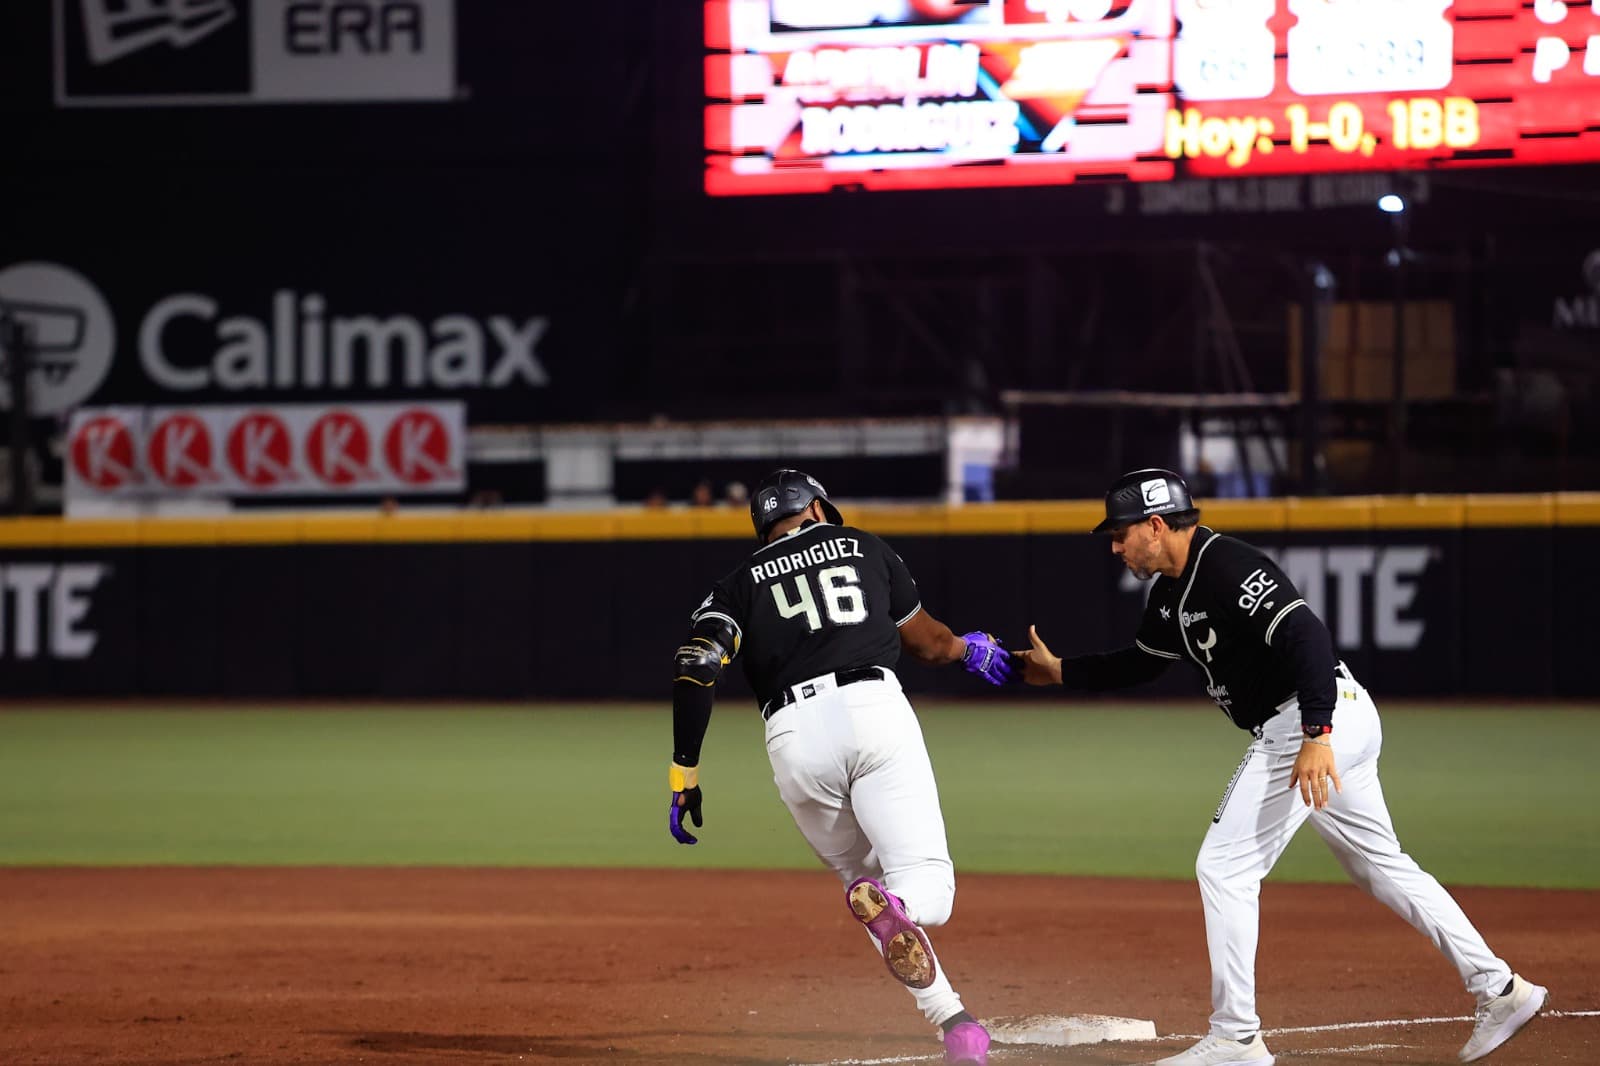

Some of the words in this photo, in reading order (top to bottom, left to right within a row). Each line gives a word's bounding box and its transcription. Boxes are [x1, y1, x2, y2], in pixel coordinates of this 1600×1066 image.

[285, 2, 424, 55] ERA
[1165, 107, 1275, 168] Hoy:
[1285, 101, 1378, 157] 1-0,
[1388, 96, 1481, 150] 1BB
[138, 289, 549, 391] Calimax
[763, 496, 778, 513] 46
[750, 537, 864, 584] RODRIGUEZ
[1237, 568, 1276, 612] abc
[0, 562, 104, 659] TE
[769, 565, 869, 632] 46
